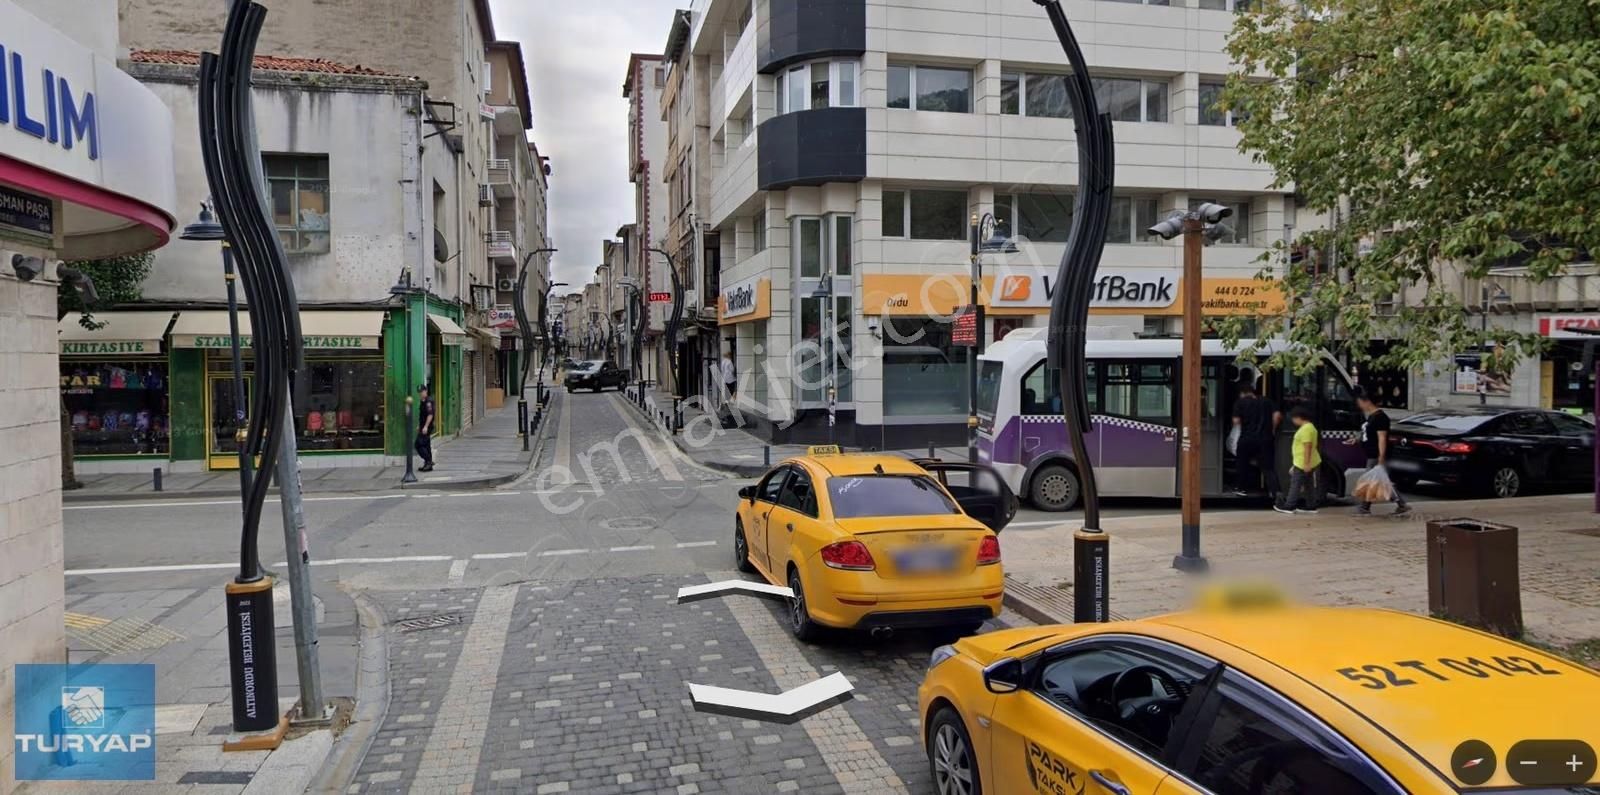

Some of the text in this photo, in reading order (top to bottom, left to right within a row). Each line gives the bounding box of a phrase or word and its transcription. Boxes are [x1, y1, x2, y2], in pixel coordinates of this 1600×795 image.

[887, 297, 909, 308] Ordu
[1215, 286, 1255, 296] 444 0 724
[194, 336, 231, 348] STAR
[1336, 656, 1562, 690] 52 T 0142
[244, 667, 257, 719] ALTINORDU
[1031, 742, 1077, 790] PARK
